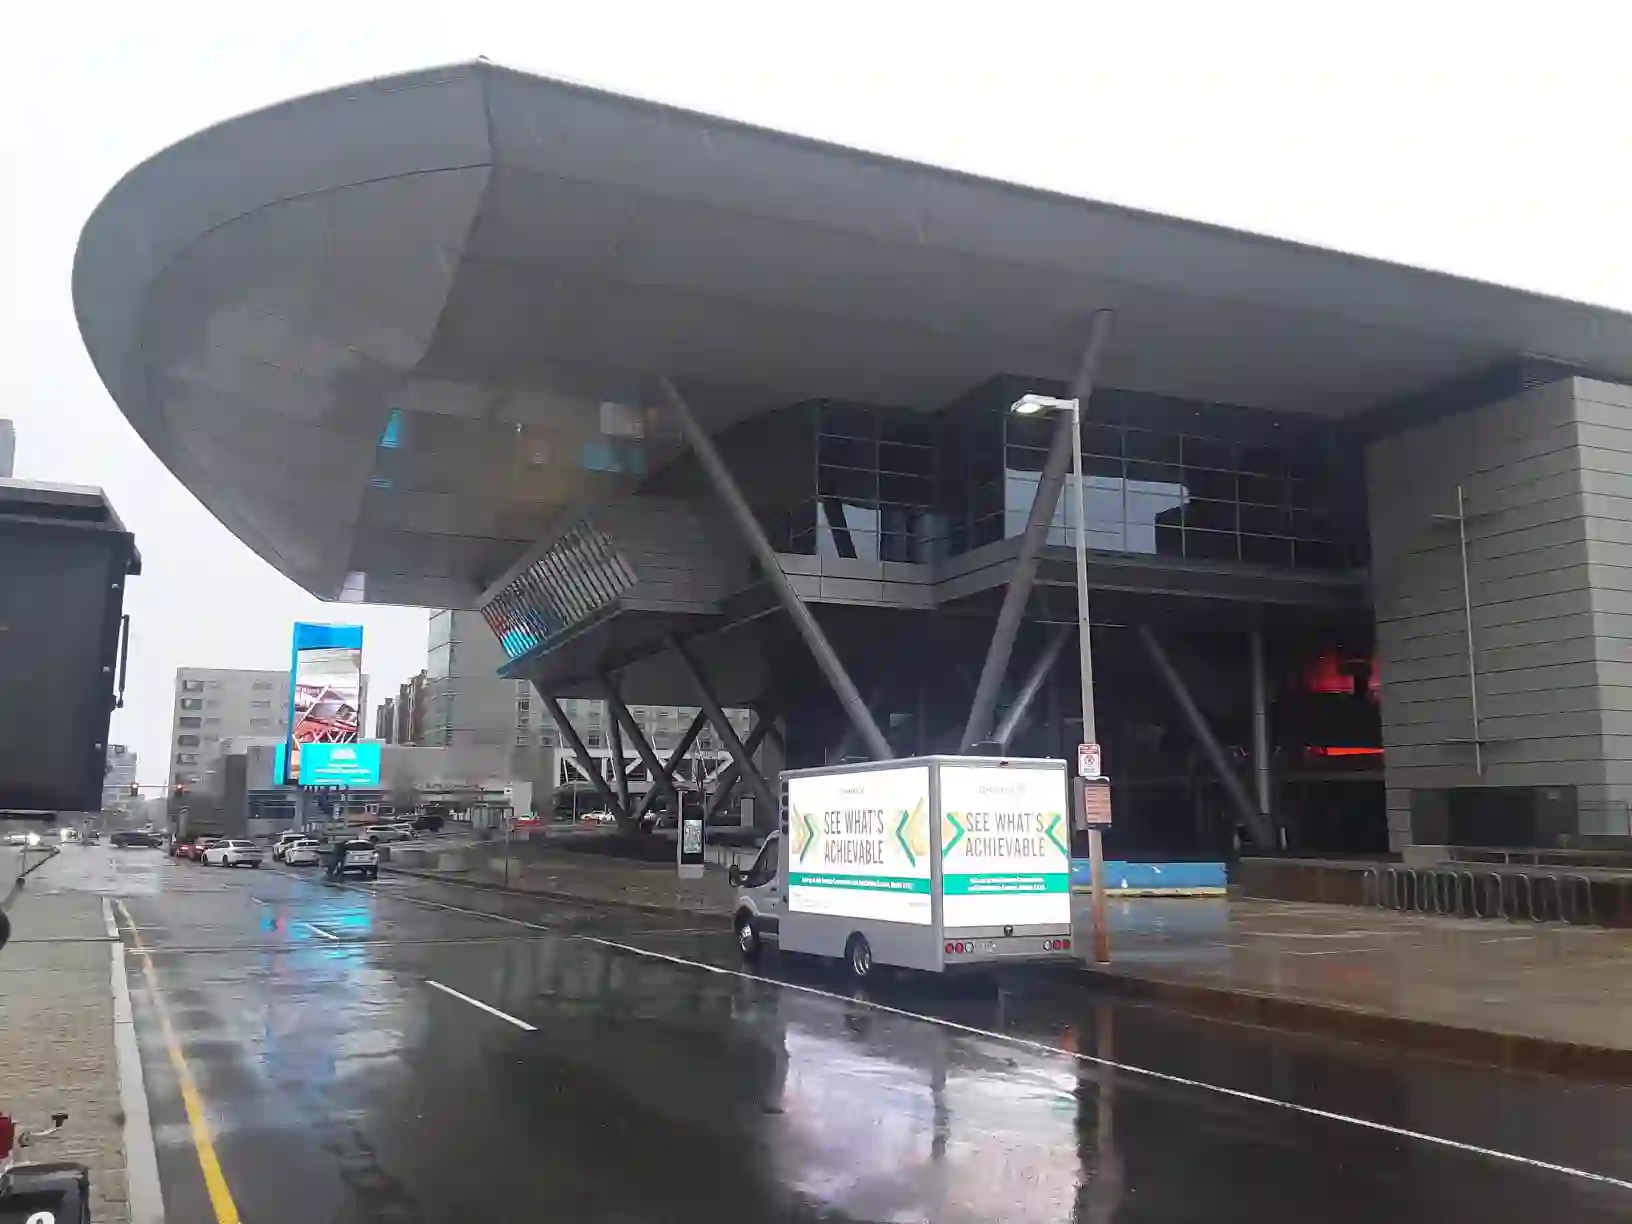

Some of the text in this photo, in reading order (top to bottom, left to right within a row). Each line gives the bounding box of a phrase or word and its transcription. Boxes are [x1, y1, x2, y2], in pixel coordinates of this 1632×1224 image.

[824, 809, 884, 835] SEE WHAT'S
[965, 810, 1044, 834] SEE WHAT'S
[824, 839, 884, 865] ACHIEVABLE
[965, 836, 1046, 857] ACHIEVABLE
